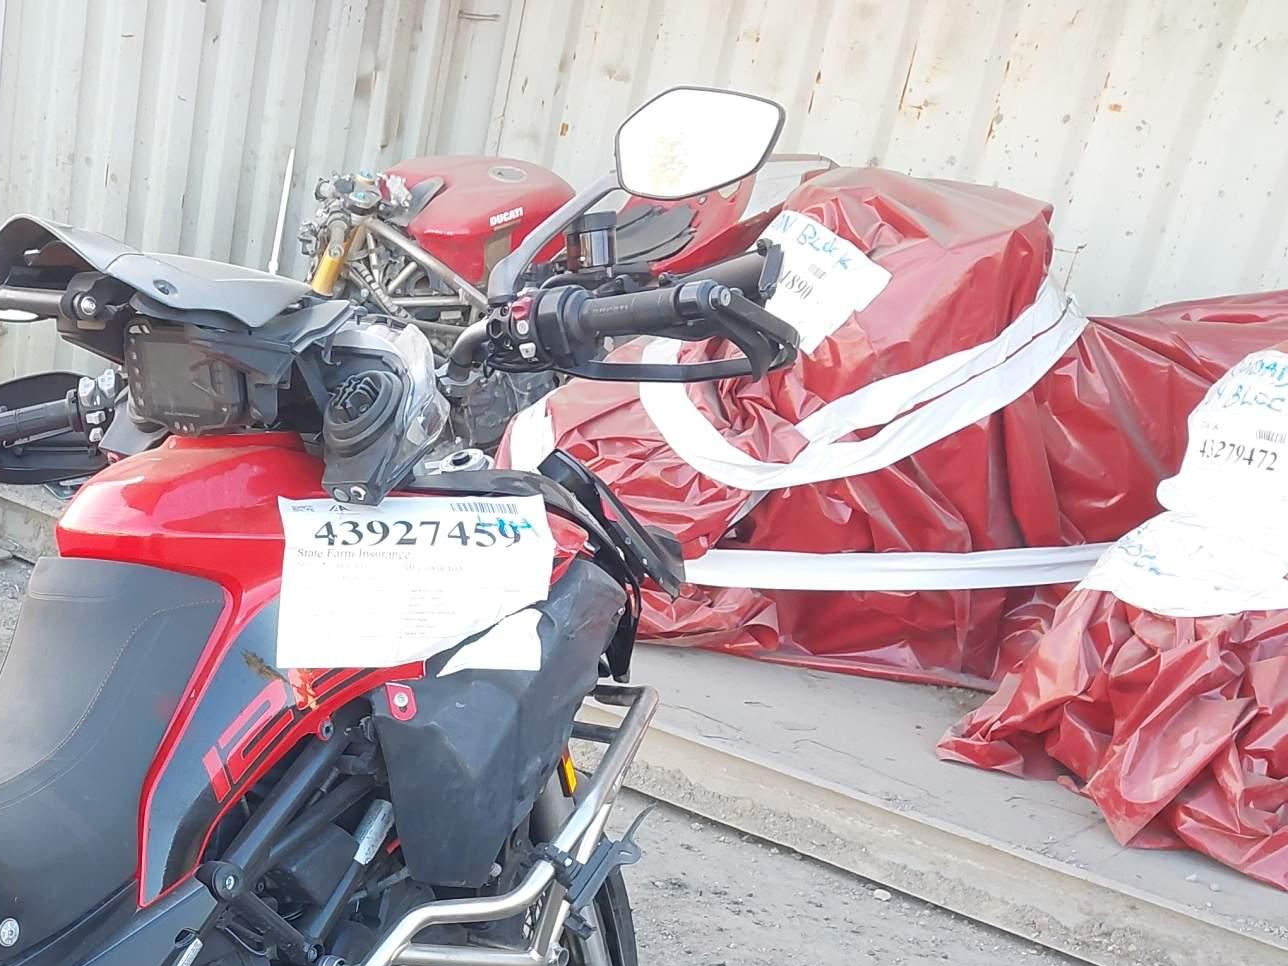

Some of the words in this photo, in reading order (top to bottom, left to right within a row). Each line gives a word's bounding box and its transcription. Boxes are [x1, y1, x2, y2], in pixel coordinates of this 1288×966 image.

[489, 206, 524, 227] DUCATI
[314, 520, 521, 548] 43927459
[296, 549, 324, 559] State
[327, 549, 353, 559] Farm
